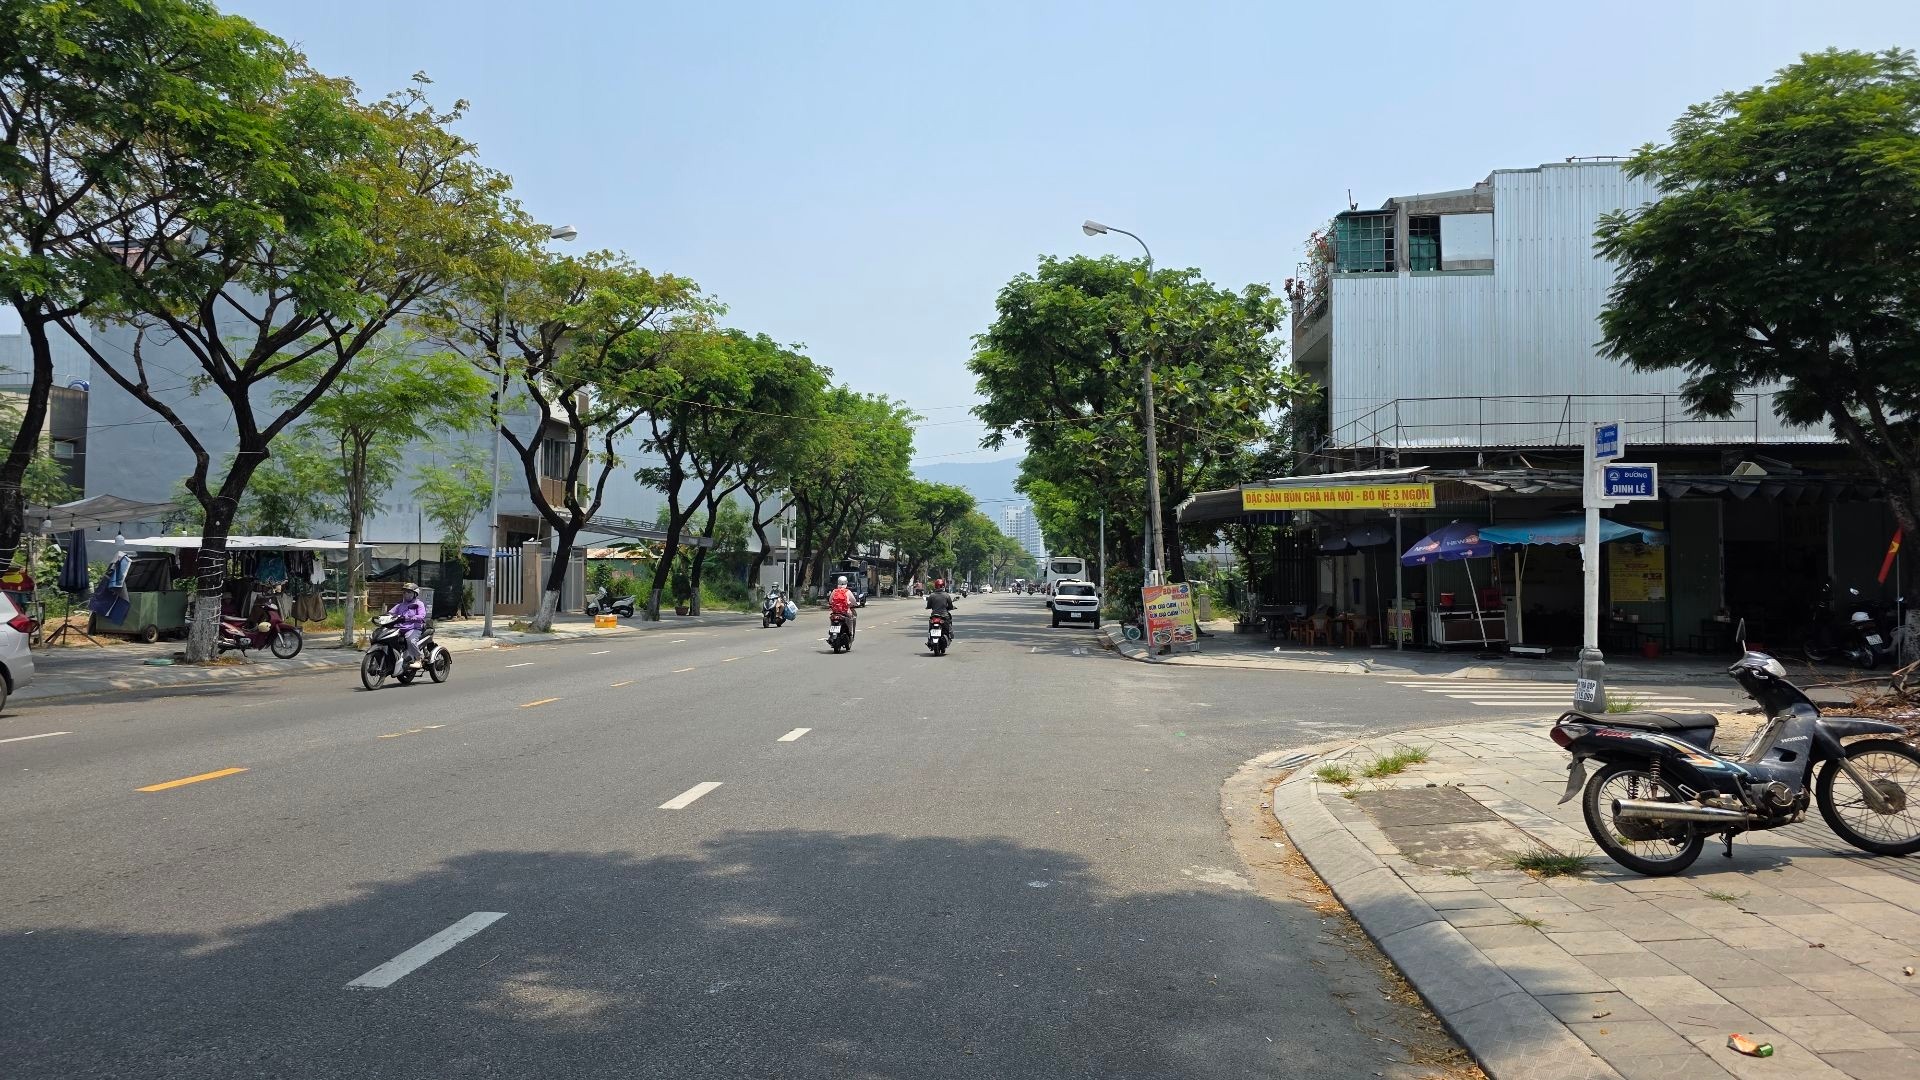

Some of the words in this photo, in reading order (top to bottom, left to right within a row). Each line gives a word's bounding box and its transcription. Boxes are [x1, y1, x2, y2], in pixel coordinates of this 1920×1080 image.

[1612, 484, 1634, 494] ĐINH
[1245, 491, 1262, 506] ĐẶC
[1393, 489, 1400, 501] 3
[1401, 488, 1430, 501] NGON
